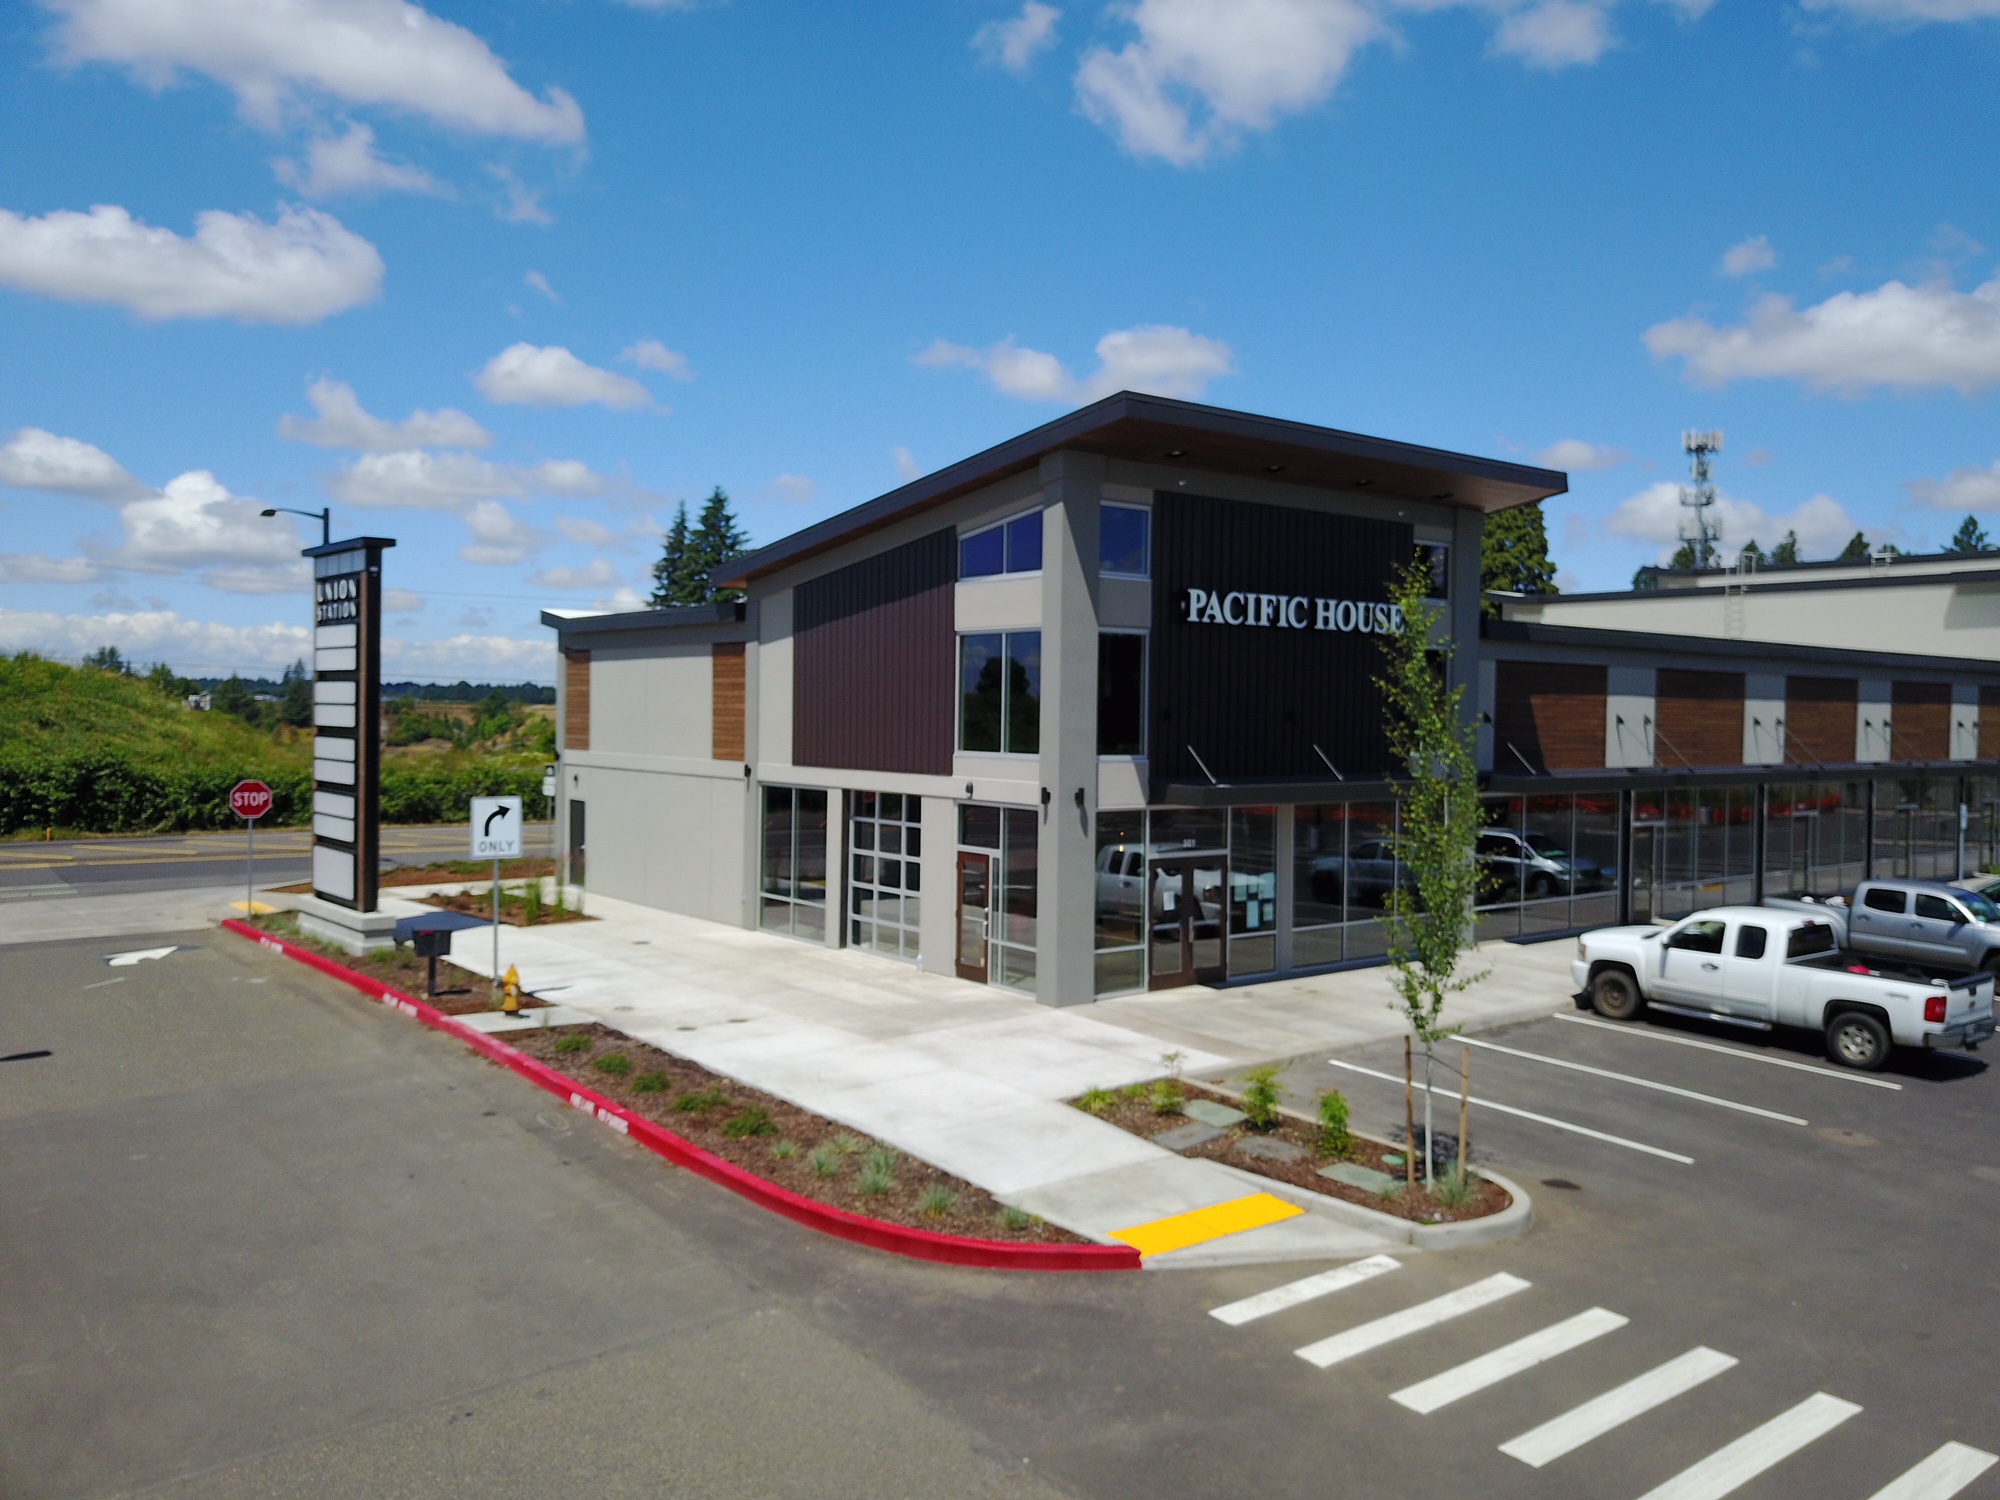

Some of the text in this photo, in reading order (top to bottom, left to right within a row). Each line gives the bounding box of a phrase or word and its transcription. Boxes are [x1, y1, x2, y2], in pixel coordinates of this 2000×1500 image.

[316, 601, 357, 622] STATION
[1187, 588, 1404, 634] PACIFIC HOUSE
[233, 791, 269, 807] STOP
[478, 840, 515, 853] ONLY
